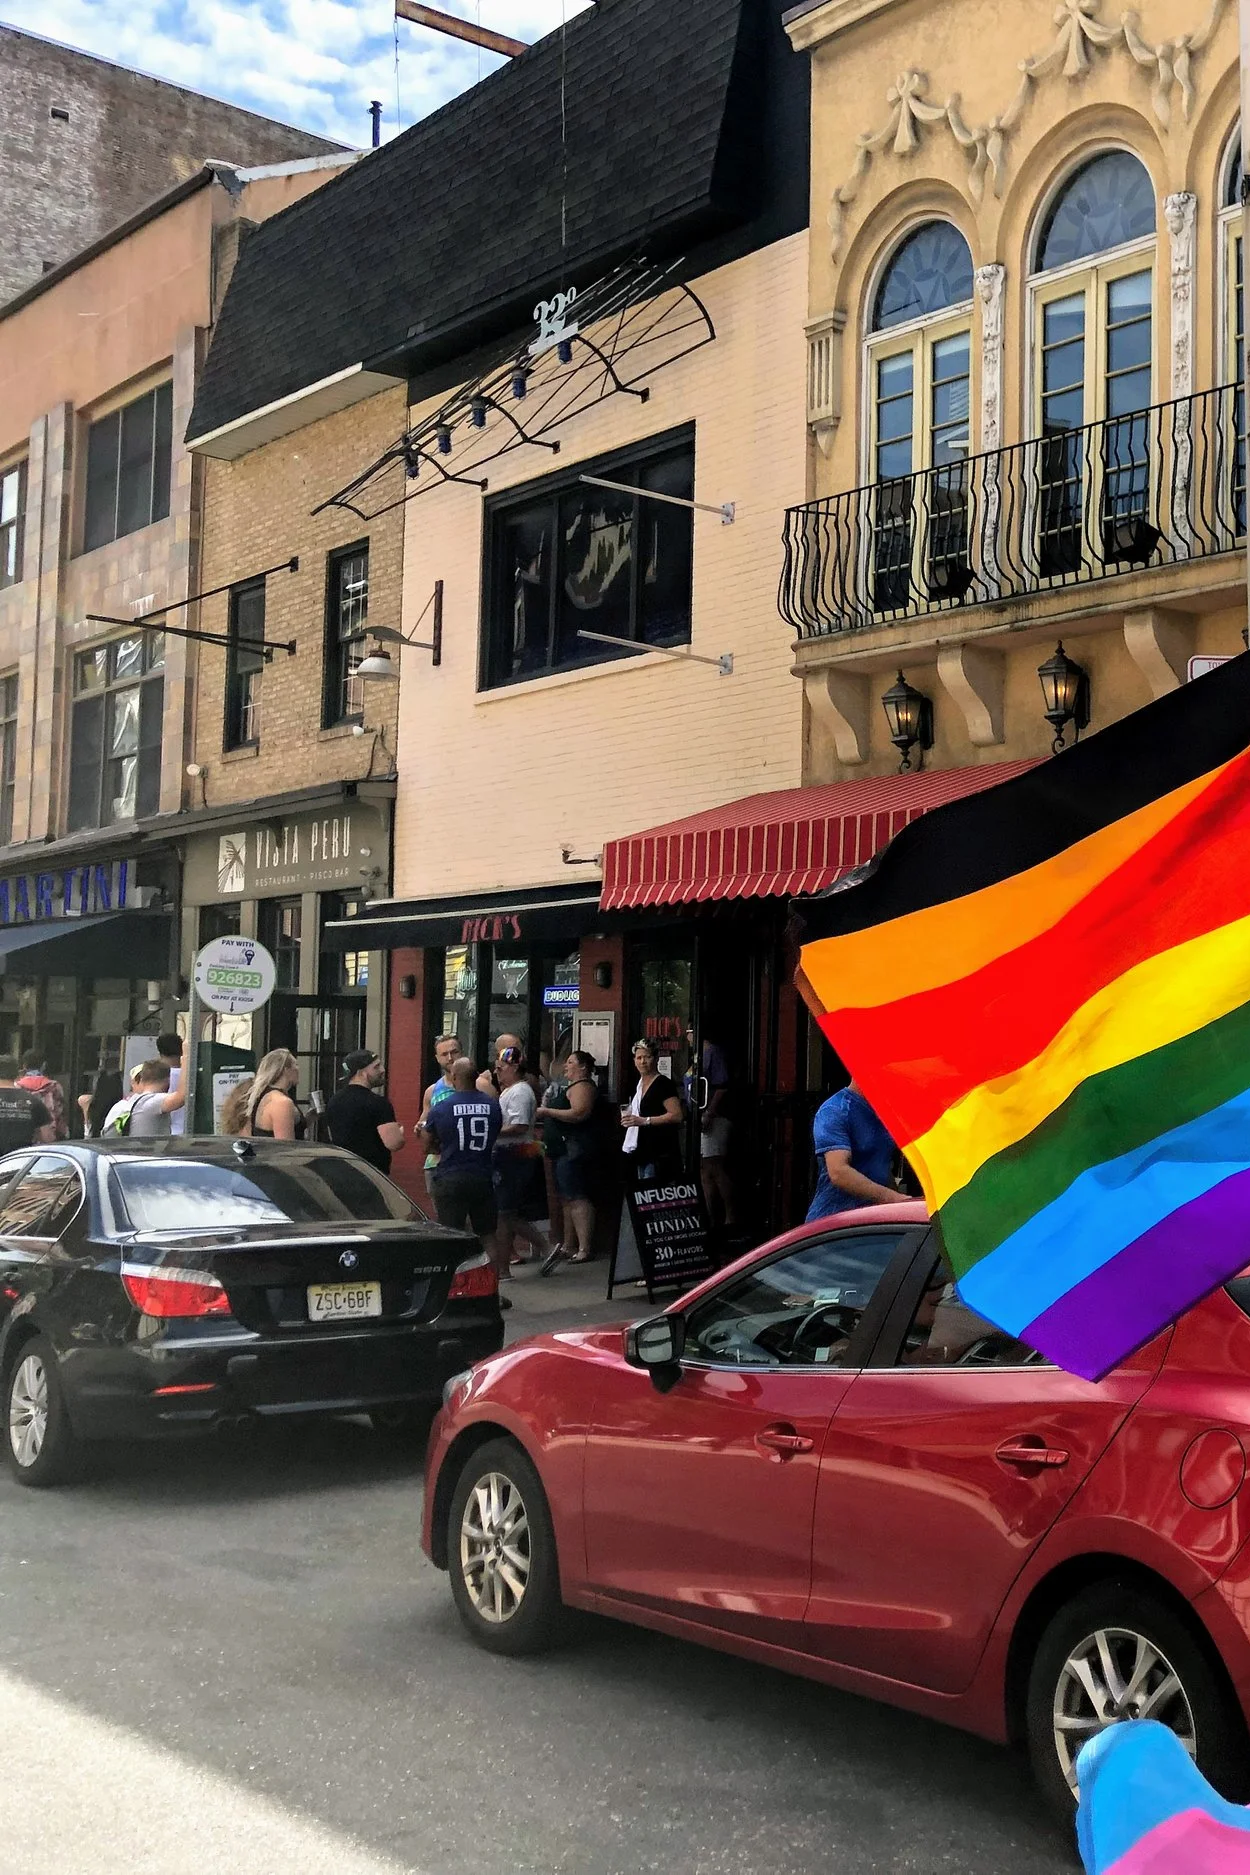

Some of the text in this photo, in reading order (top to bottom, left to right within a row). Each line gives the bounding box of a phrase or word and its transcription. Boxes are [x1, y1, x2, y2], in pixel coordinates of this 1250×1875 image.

[311, 816, 350, 862] PERU
[256, 867, 349, 887] RESTAURANT PISCO BAR
[221, 939, 254, 948] PAY WITH
[208, 970, 261, 987] 926823
[456, 1117, 489, 1151] 19
[634, 1184, 698, 1205] INFUSION
[645, 1216, 701, 1235] FUNDAY
[655, 1245, 704, 1260] 30 FLAVORS
